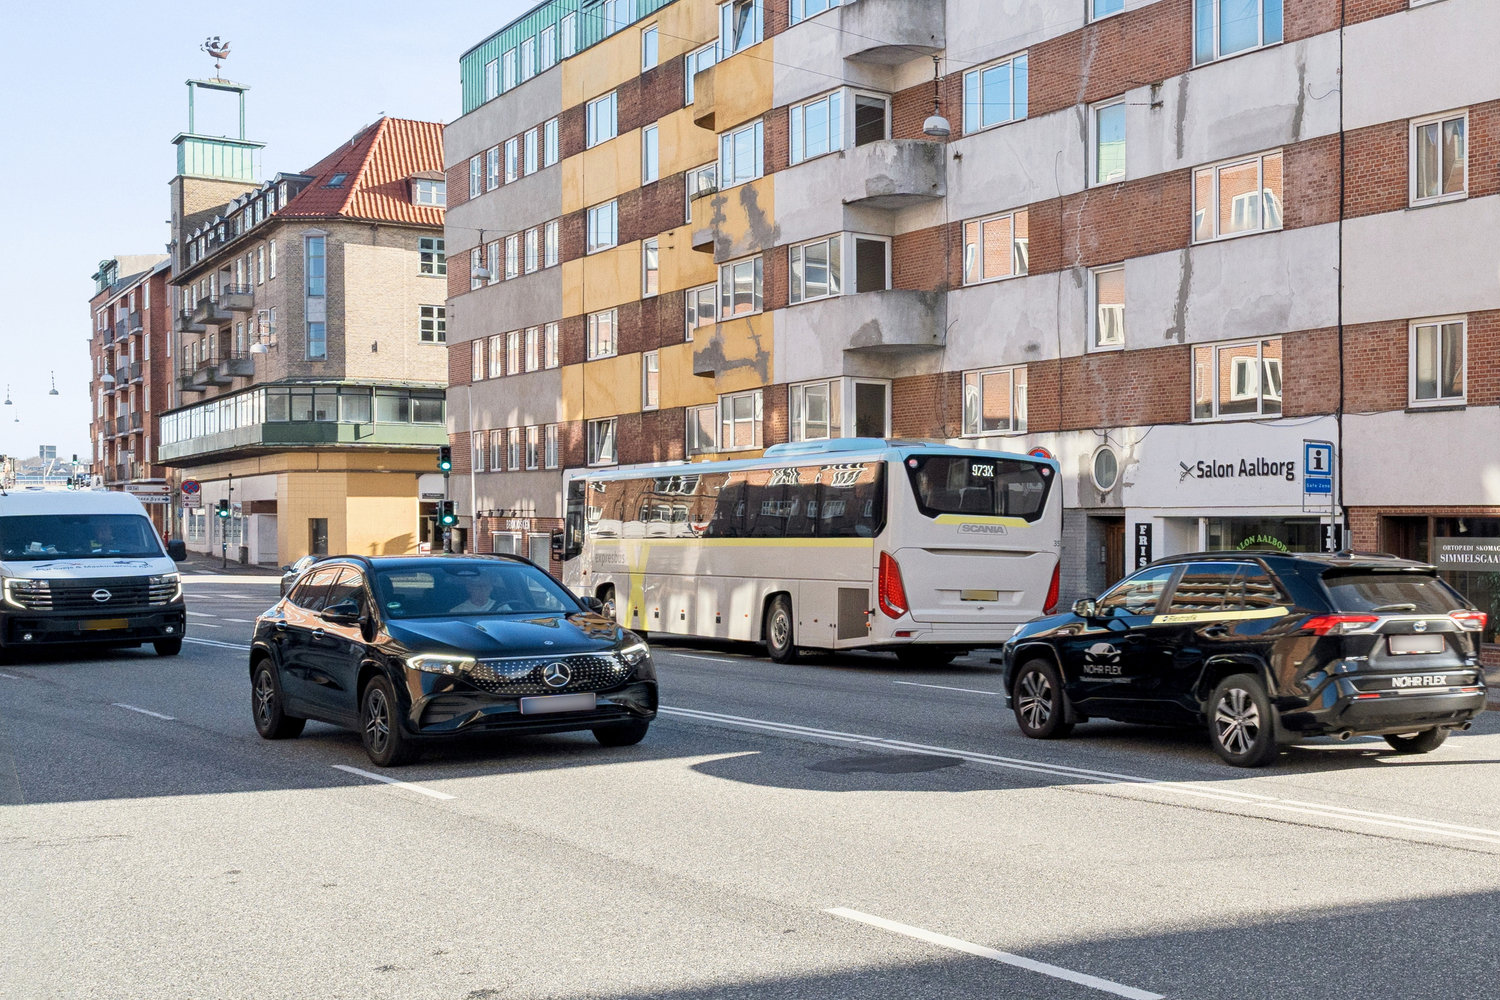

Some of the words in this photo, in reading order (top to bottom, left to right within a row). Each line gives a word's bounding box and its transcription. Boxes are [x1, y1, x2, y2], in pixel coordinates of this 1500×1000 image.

[972, 464, 994, 477] 973X
[1196, 459, 1234, 478] Salon
[1238, 457, 1295, 481] Aalborg
[962, 524, 1004, 534] SCANIA
[1236, 535, 1255, 551] ALON
[1256, 534, 1291, 553] AALBOR
[595, 551, 625, 566] expresbus
[1105, 665, 1122, 675] FLEX
[1423, 675, 1447, 686] FLEX
